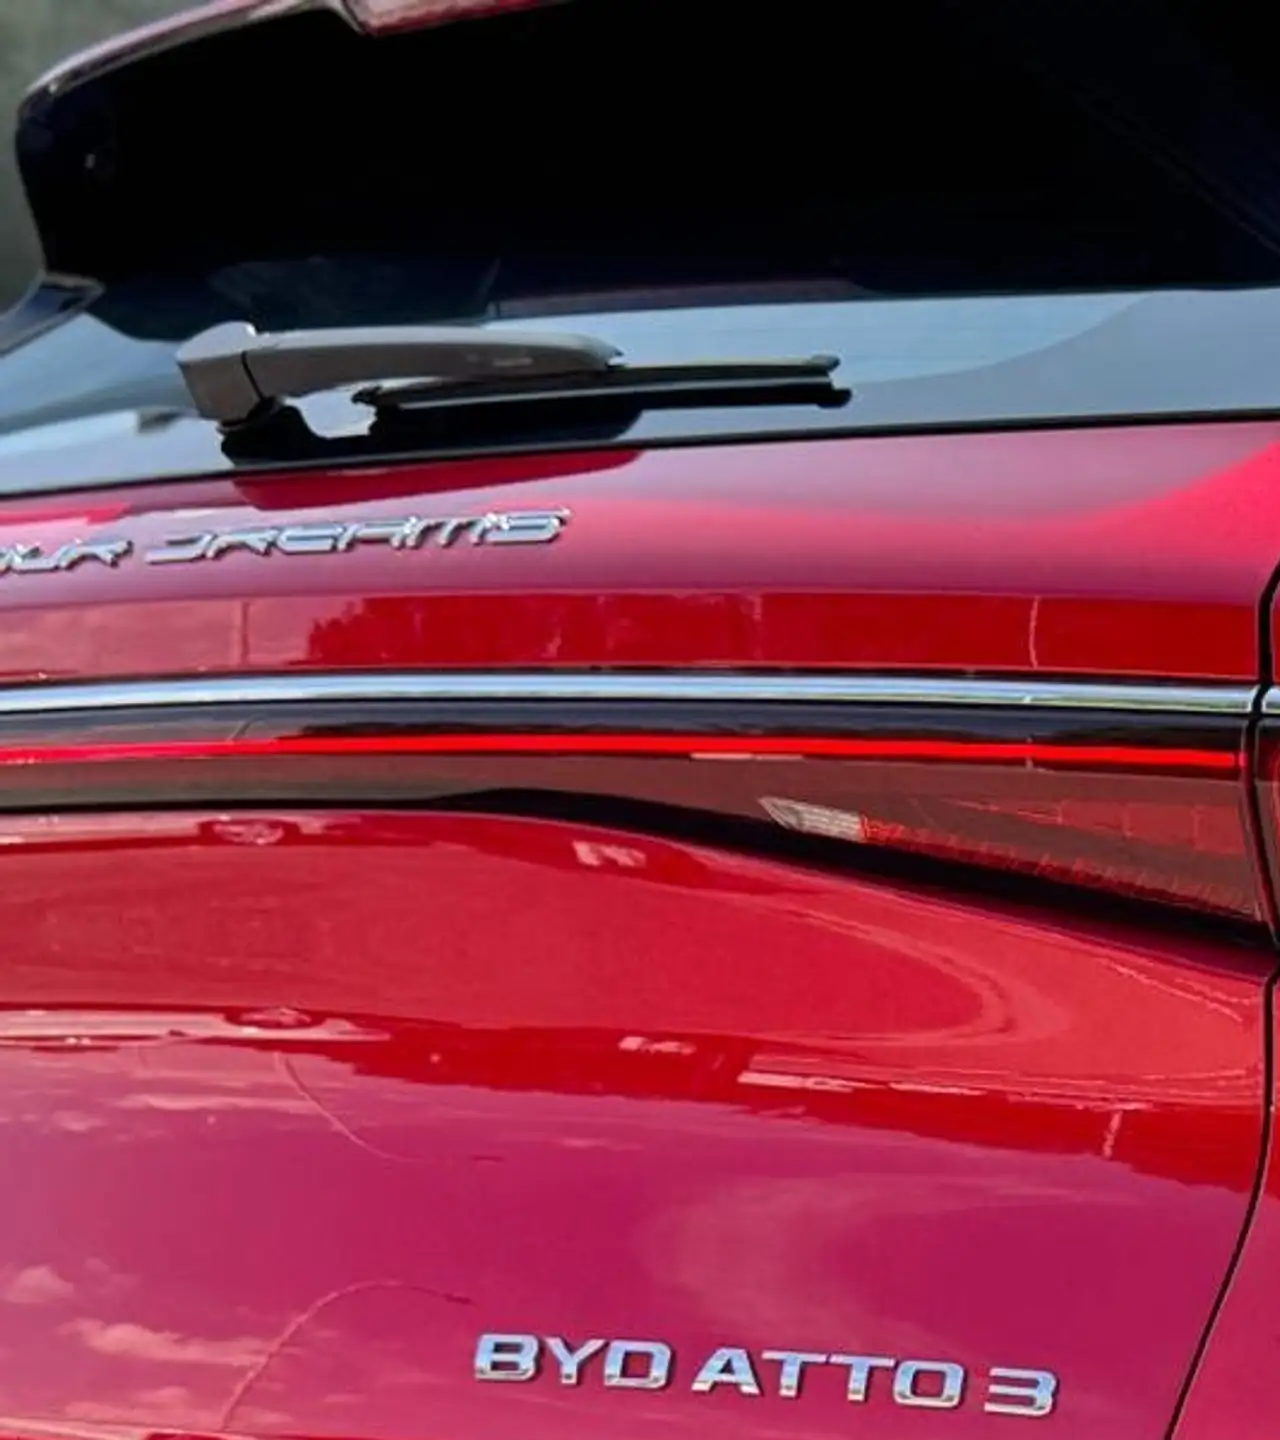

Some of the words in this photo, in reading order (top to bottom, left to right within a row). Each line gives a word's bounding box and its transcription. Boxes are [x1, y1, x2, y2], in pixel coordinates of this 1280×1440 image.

[145, 506, 571, 565] DREAMS
[475, 1333, 672, 1389] BYD
[691, 1347, 966, 1408] ATTO
[983, 1366, 1058, 1417] 3
